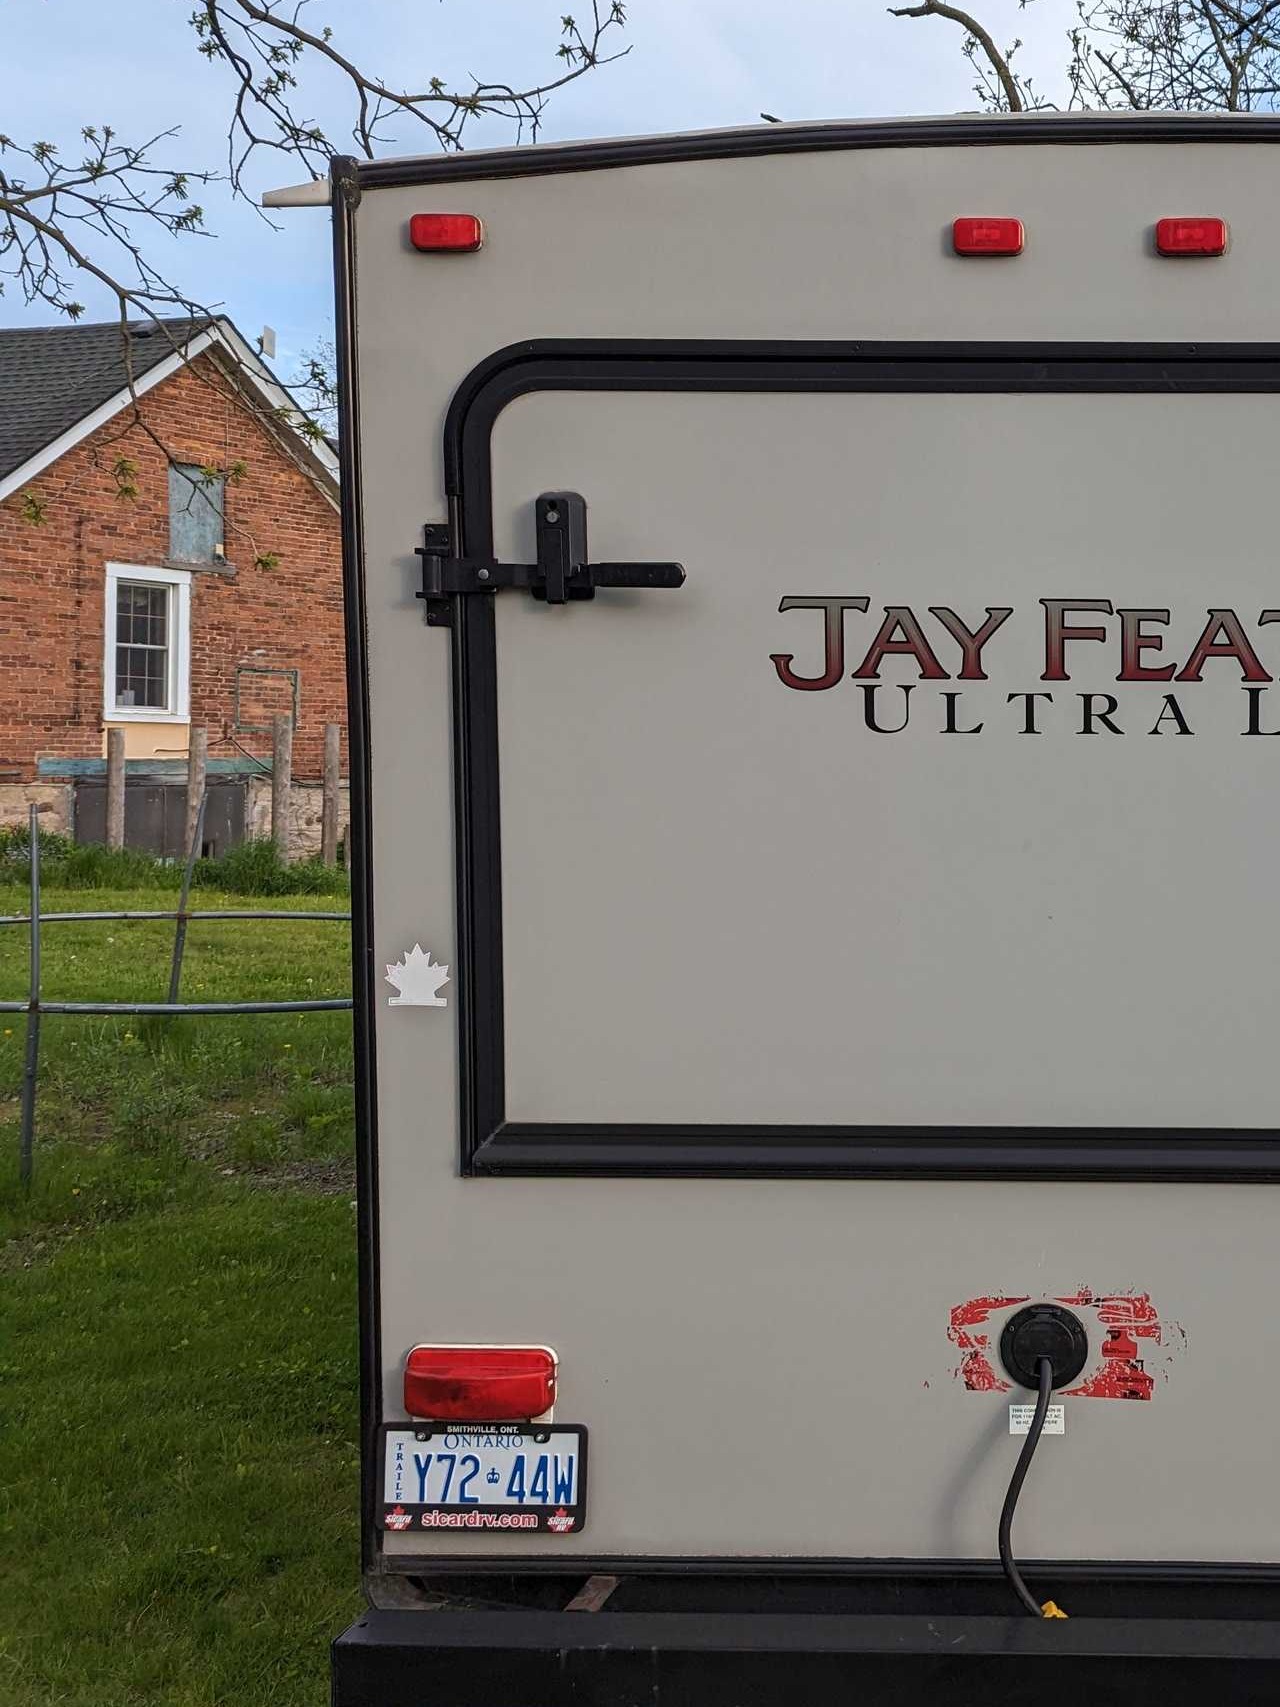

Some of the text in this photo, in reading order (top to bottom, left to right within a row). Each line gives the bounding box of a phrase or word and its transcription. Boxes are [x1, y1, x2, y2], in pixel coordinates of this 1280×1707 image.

[769, 595, 1014, 691] JAY
[857, 684, 1195, 737] ULTRA
[444, 1434, 524, 1450] ONTARIO
[447, 1425, 520, 1434] SMITHVILLE, ONT.
[395, 1442, 404, 1501] TRAILE
[413, 1453, 574, 1505] Y72 44W
[420, 1509, 539, 1529] sicardrv.com
